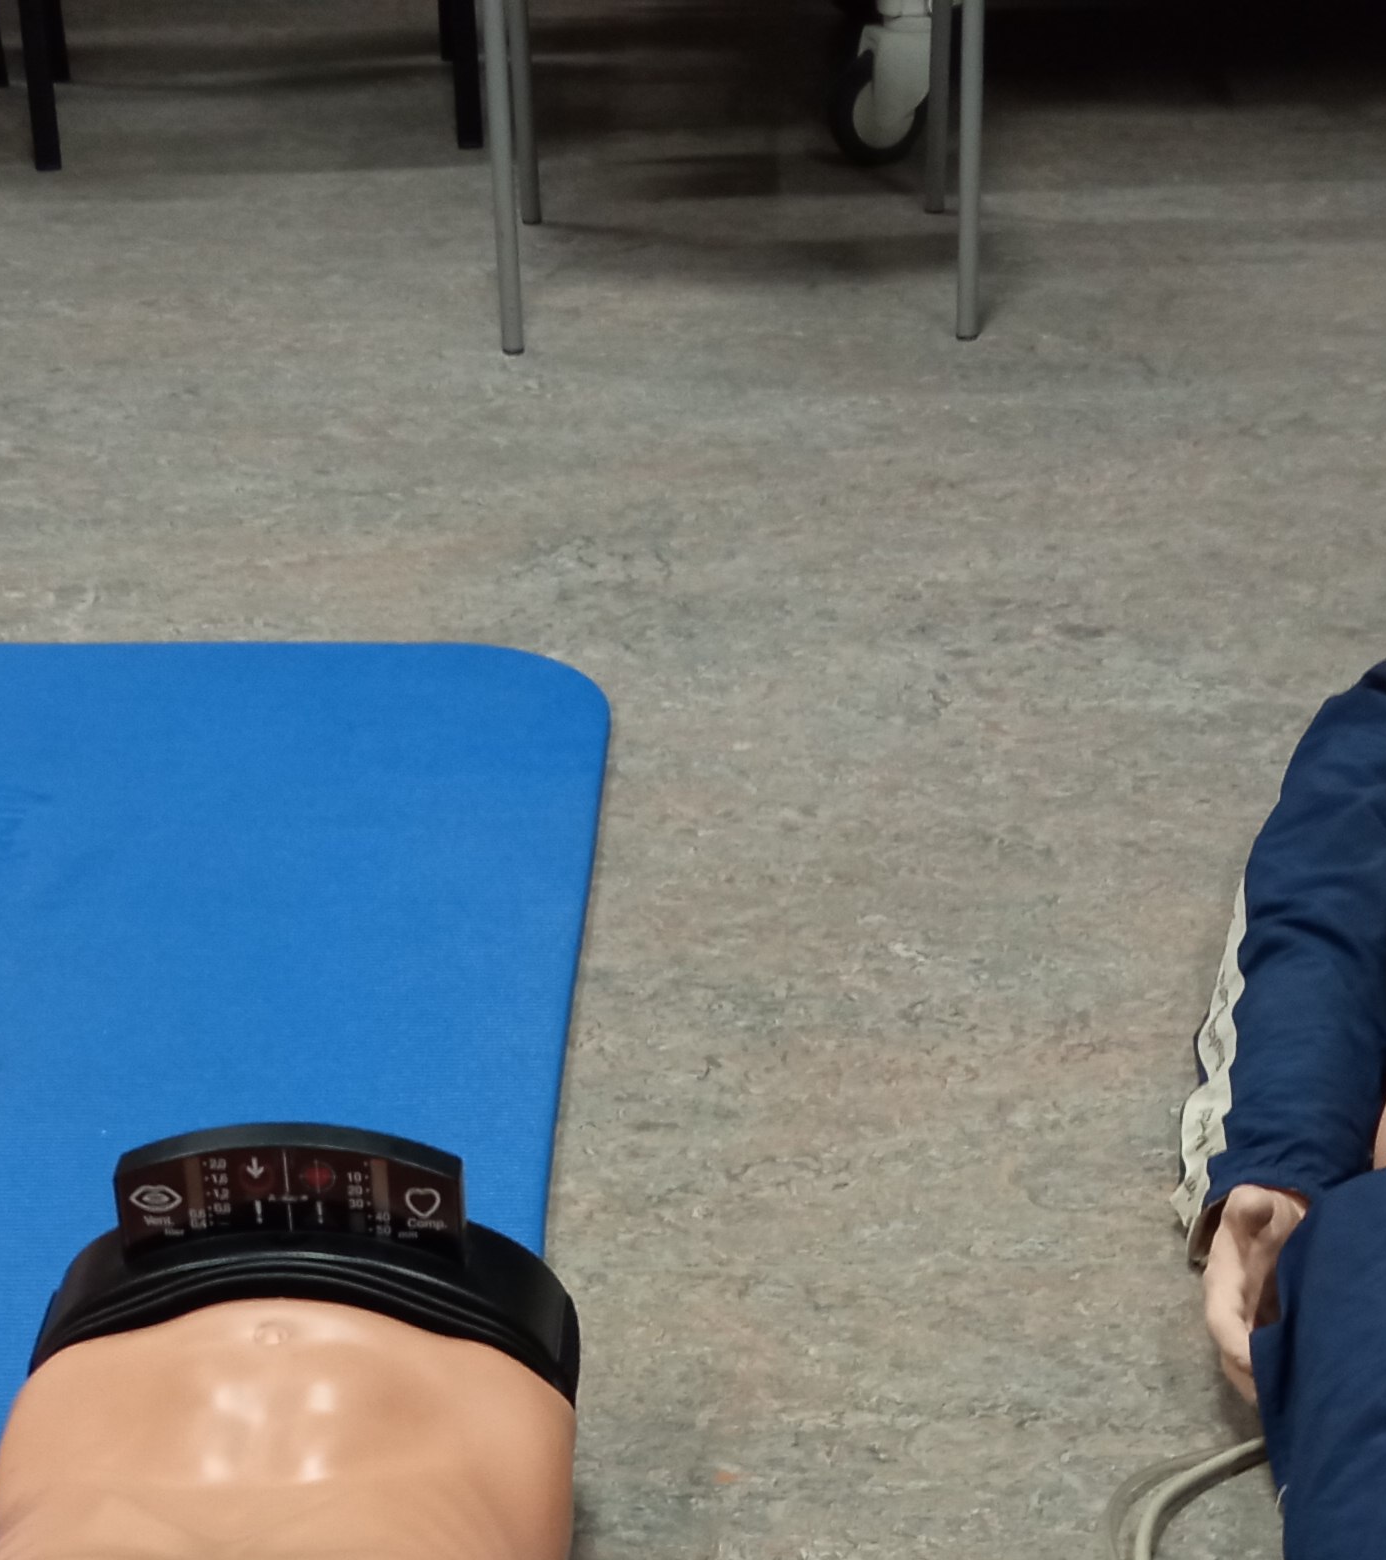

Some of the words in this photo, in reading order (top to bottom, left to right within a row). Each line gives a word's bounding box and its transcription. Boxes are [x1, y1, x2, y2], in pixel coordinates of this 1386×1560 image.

[346, 1171, 363, 1184] 10
[348, 1198, 365, 1210] 30
[374, 1211, 391, 1222] 40
[376, 1224, 392, 1236] 50
[407, 1217, 448, 1232] Comp.
